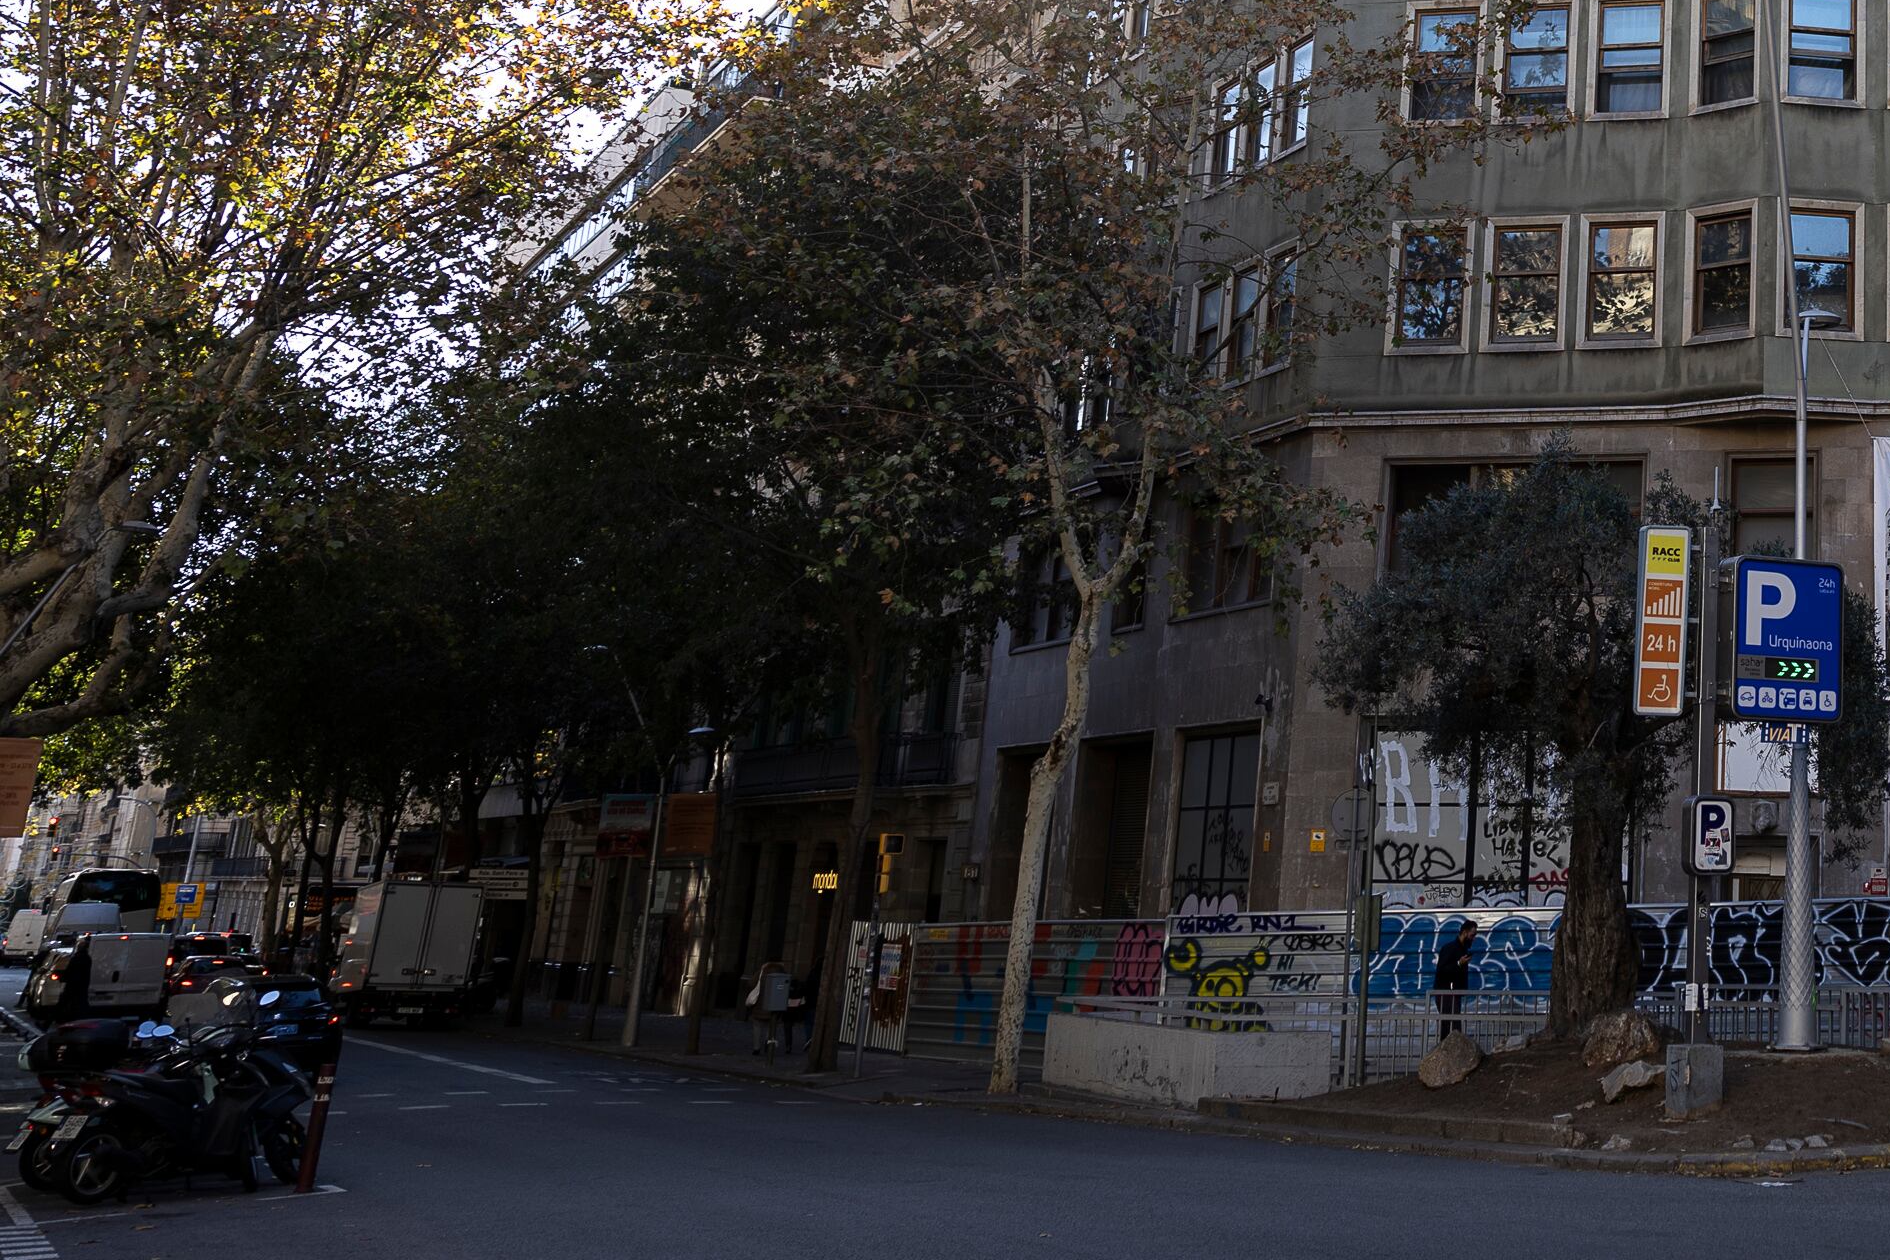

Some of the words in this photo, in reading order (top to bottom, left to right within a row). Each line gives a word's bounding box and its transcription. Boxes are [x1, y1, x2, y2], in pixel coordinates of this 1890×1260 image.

[1652, 547, 1681, 557] RACC
[1818, 578, 1836, 589] 24h
[1745, 569, 1797, 646] P
[1646, 634, 1664, 652] 24
[1667, 634, 1676, 652] h
[1769, 634, 1834, 652] Urquinaona
[1700, 804, 1726, 845] P
